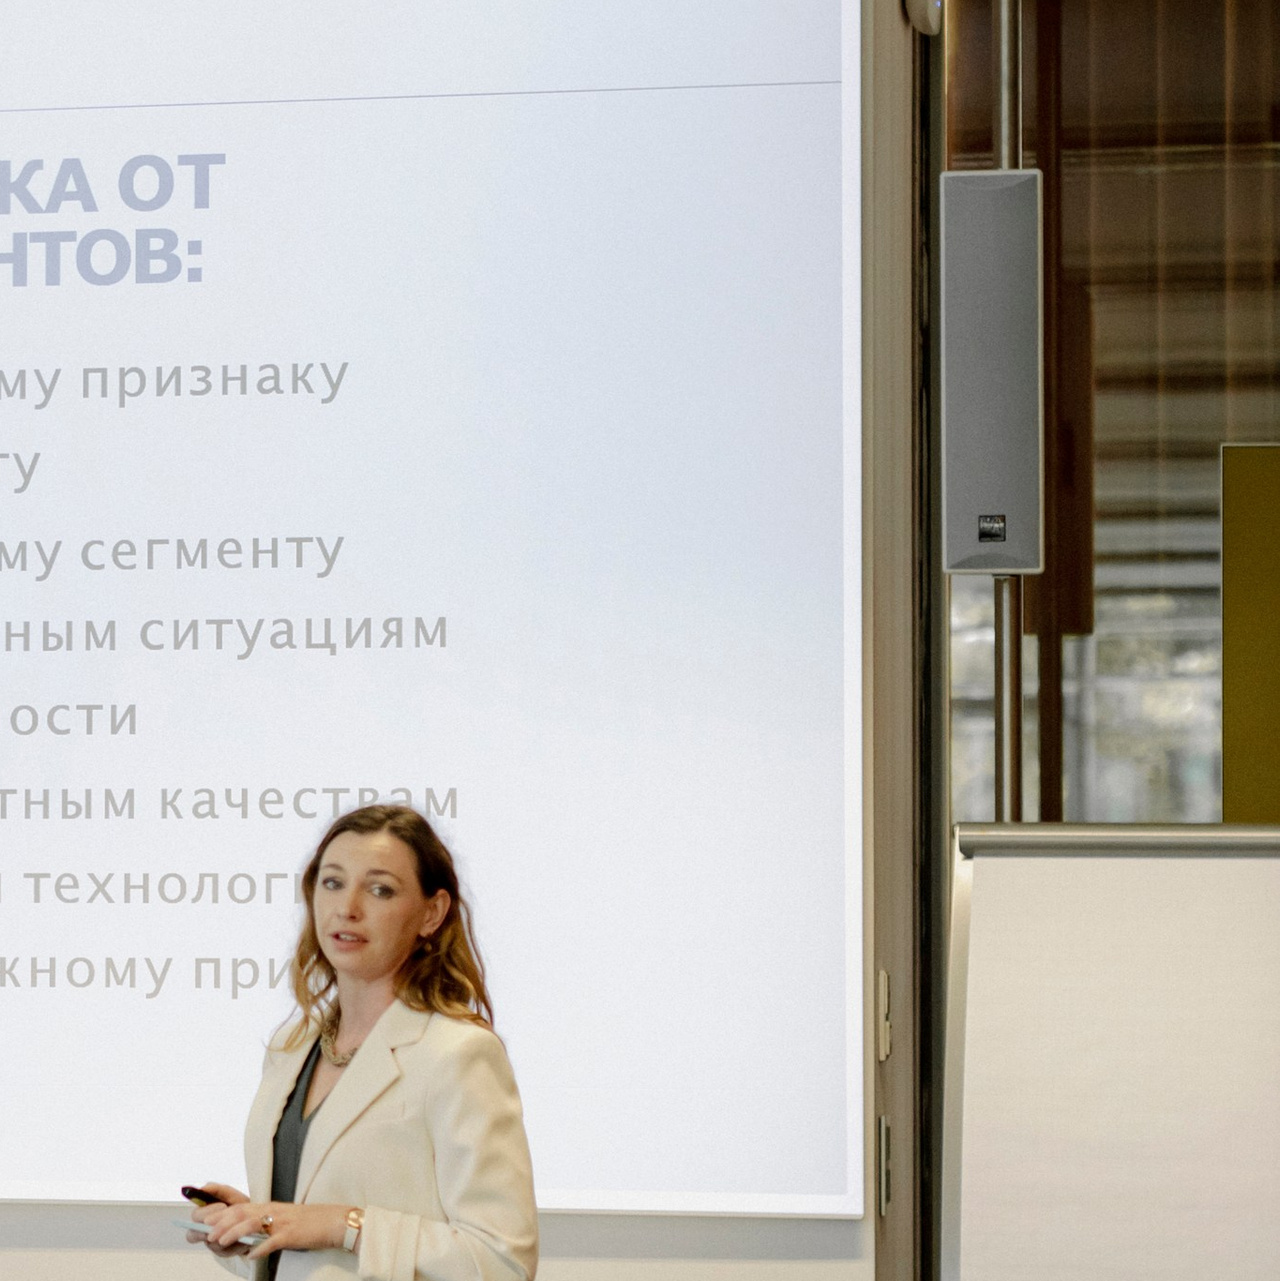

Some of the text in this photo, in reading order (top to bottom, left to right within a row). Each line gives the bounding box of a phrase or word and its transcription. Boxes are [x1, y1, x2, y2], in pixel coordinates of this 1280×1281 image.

[117, 152, 227, 214] ОТ
[80, 360, 350, 411] признаку
[79, 535, 346, 580] сегменту
[138, 615, 448, 662] ситуациям
[22, 871, 302, 905] технолог
[193, 956, 294, 1001] при
